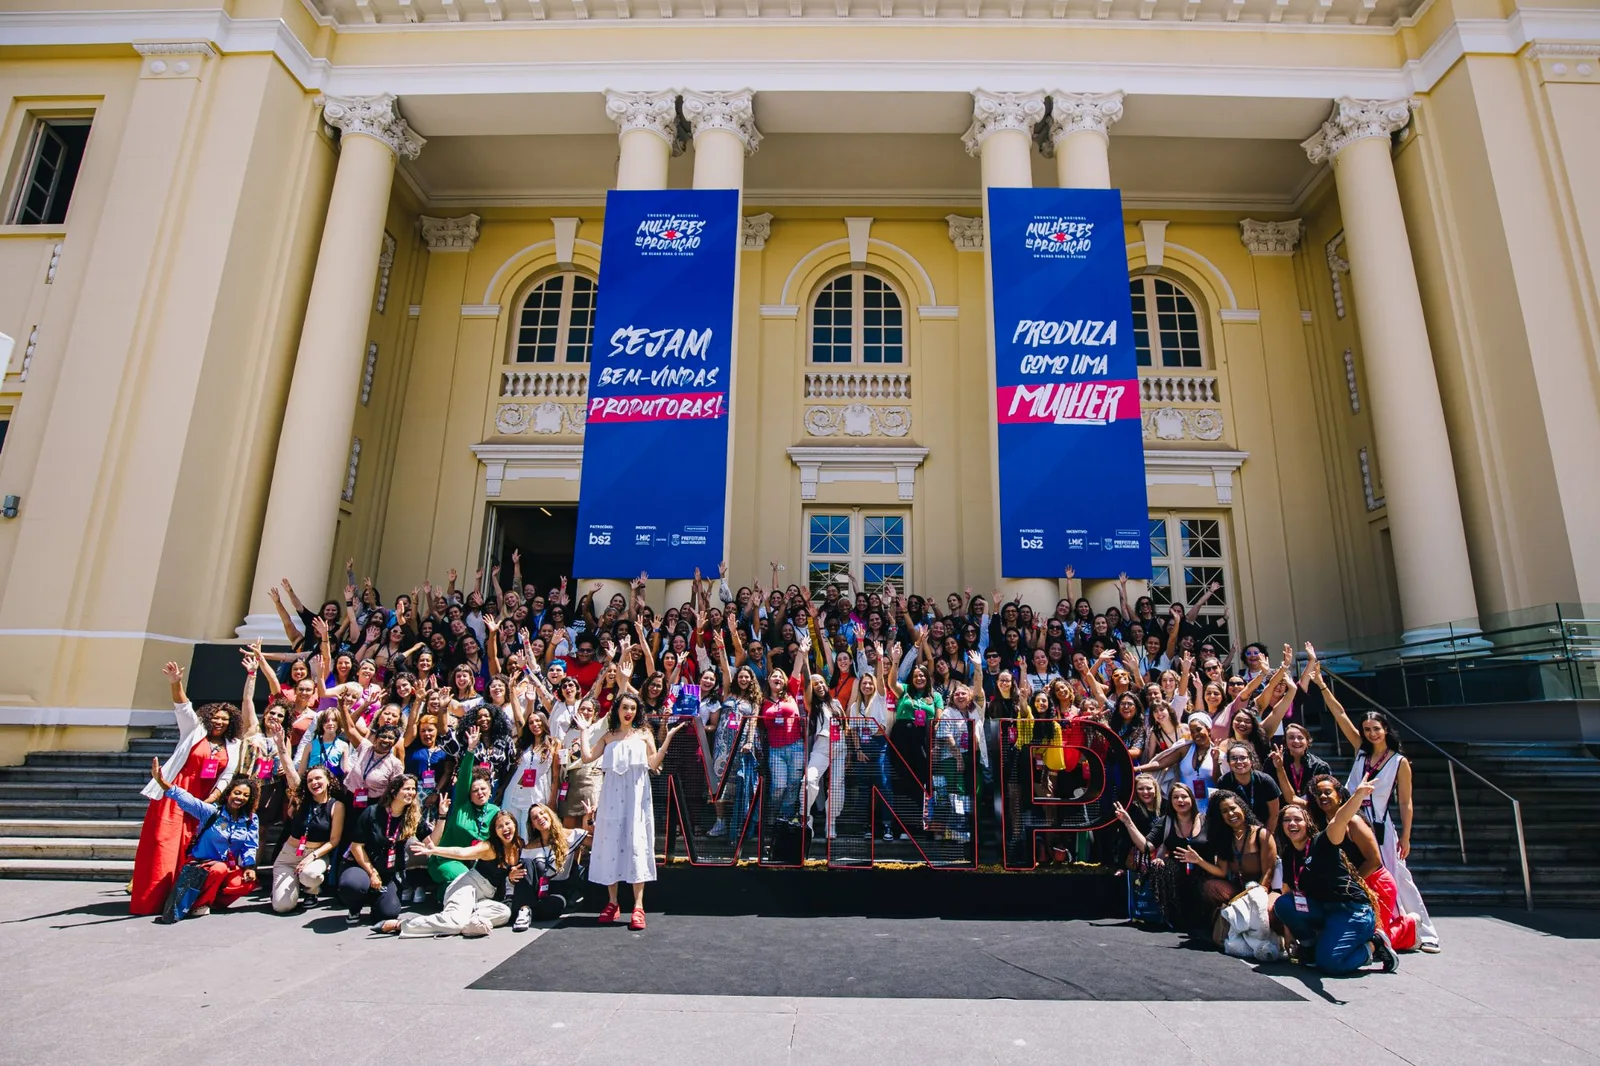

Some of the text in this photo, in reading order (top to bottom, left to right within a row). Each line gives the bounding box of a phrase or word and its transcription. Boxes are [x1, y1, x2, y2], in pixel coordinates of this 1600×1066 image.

[636, 215, 706, 236] MULHERES
[1026, 217, 1094, 238] MULHERES
[642, 235, 700, 252] PRODUÇÃO
[1033, 238, 1092, 254] PRODUÇÃO
[608, 325, 712, 360] SEJAM
[1012, 320, 1116, 348] PRODUZA
[1020, 354, 1108, 375] COMO UMA
[597, 365, 720, 387] BEM-VINDAS
[589, 395, 722, 419] PRODUTORAS!
[1008, 382, 1125, 425] MULHER
[589, 532, 612, 545] bs2
[1021, 536, 1043, 549] bs2
